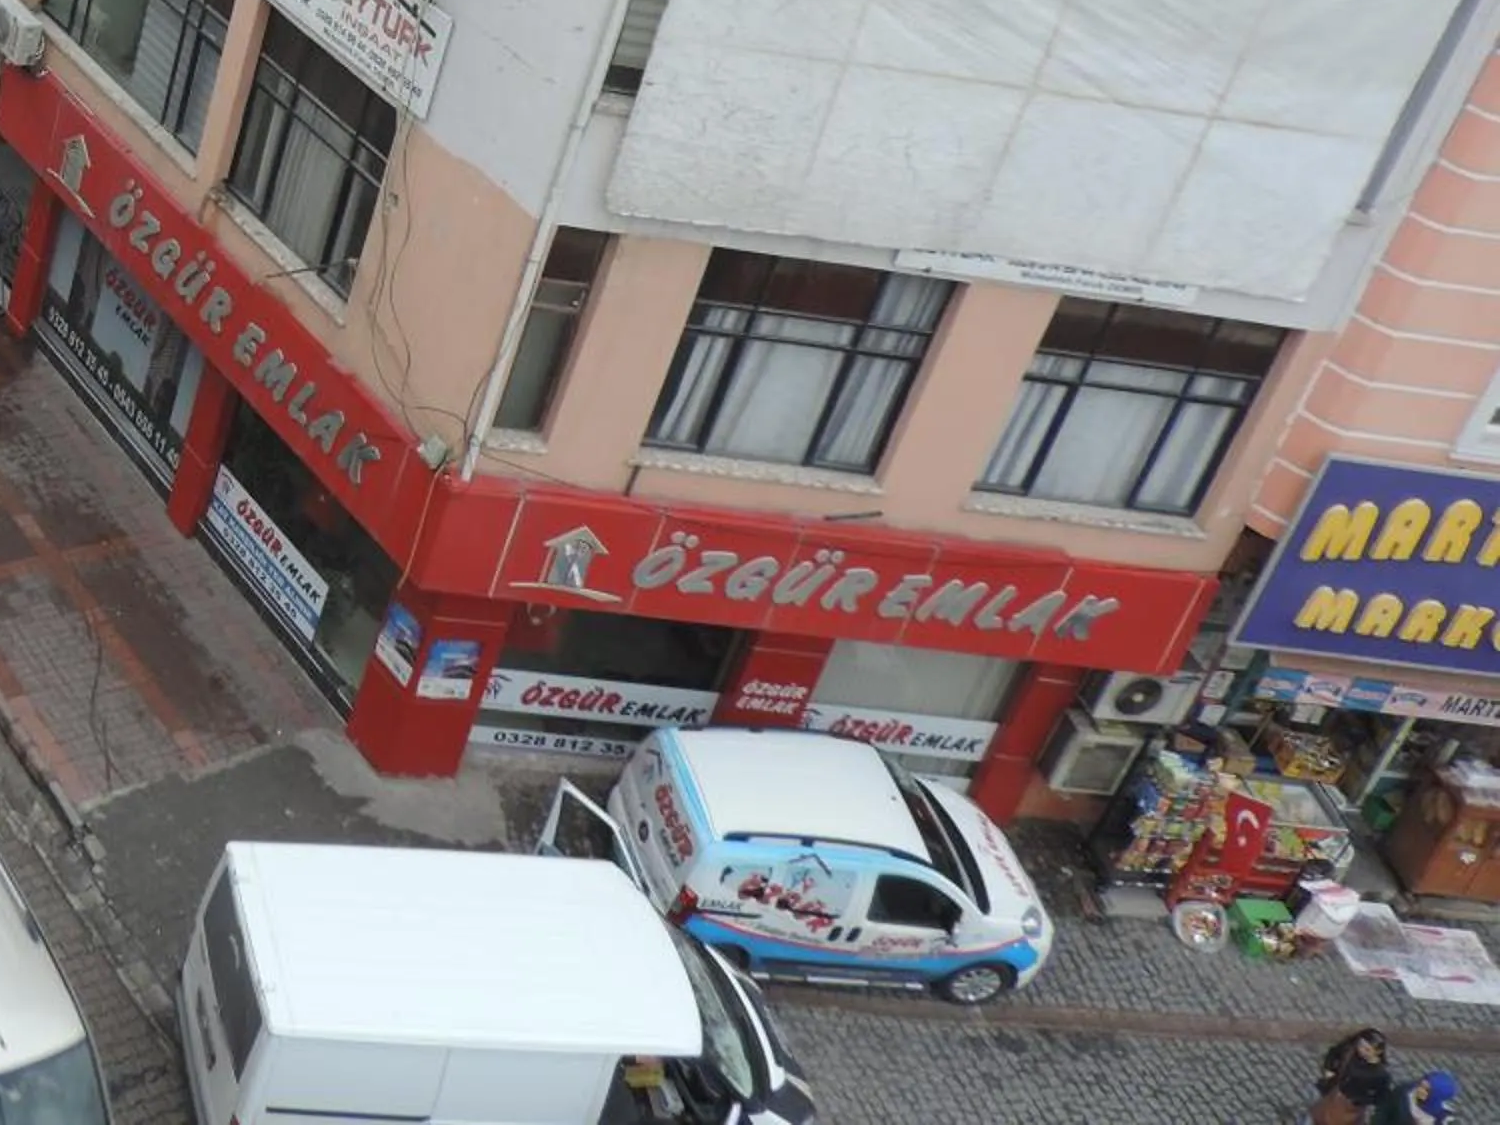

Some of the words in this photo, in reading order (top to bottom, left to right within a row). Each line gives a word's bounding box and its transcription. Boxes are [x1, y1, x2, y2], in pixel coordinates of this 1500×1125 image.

[106, 266, 159, 328] ÖZGÜR
[109, 178, 233, 334] ÖZGÜR
[232, 322, 381, 485] EMLAK
[115, 303, 150, 347] EMLAK
[236, 499, 283, 559] ÖZGÜR
[279, 555, 321, 604] EMLAK
[632, 530, 879, 613] ÖZGÜR
[876, 574, 1121, 641] EMLAK
[1294, 585, 1500, 651] MARK
[520, 680, 623, 716] ÖZGÜR
[620, 700, 708, 724] EMLAK
[735, 695, 801, 716] EMLAK
[742, 679, 808, 700] ÖZGÜR
[493, 729, 547, 747] 0328
[553, 735, 595, 753] 812
[599, 741, 626, 756] 35
[829, 713, 914, 746] ÖZGÜR
[910, 731, 985, 754] EMLAK
[654, 782, 694, 863] ÖZGÜR
[701, 897, 743, 911] EMLAK
